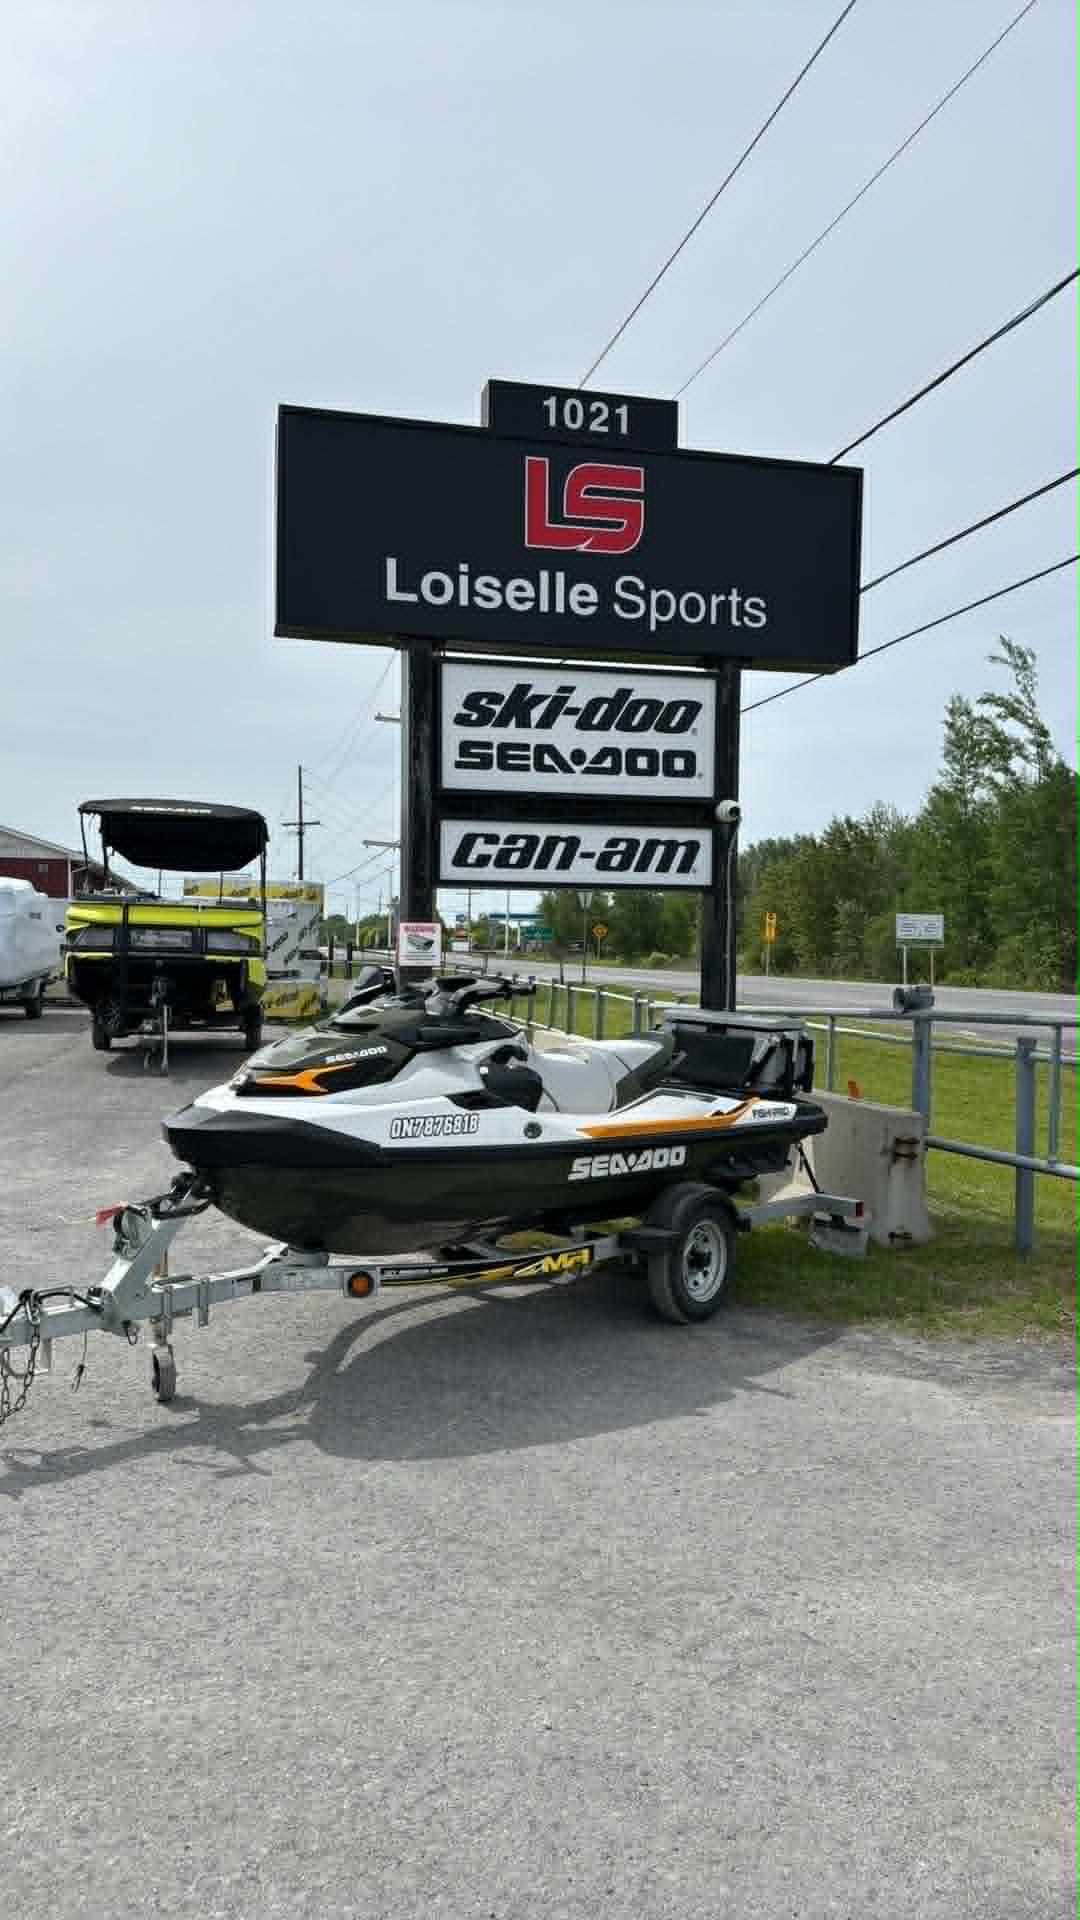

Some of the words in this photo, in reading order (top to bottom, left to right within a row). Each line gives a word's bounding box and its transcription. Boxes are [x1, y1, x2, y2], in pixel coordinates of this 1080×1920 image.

[543, 396, 630, 435] 1021
[524, 456, 647, 554] LS
[385, 556, 599, 616] Loiselle
[613, 575, 767, 632] Sports
[453, 683, 703, 734] ski-doo
[451, 832, 701, 874] can-am
